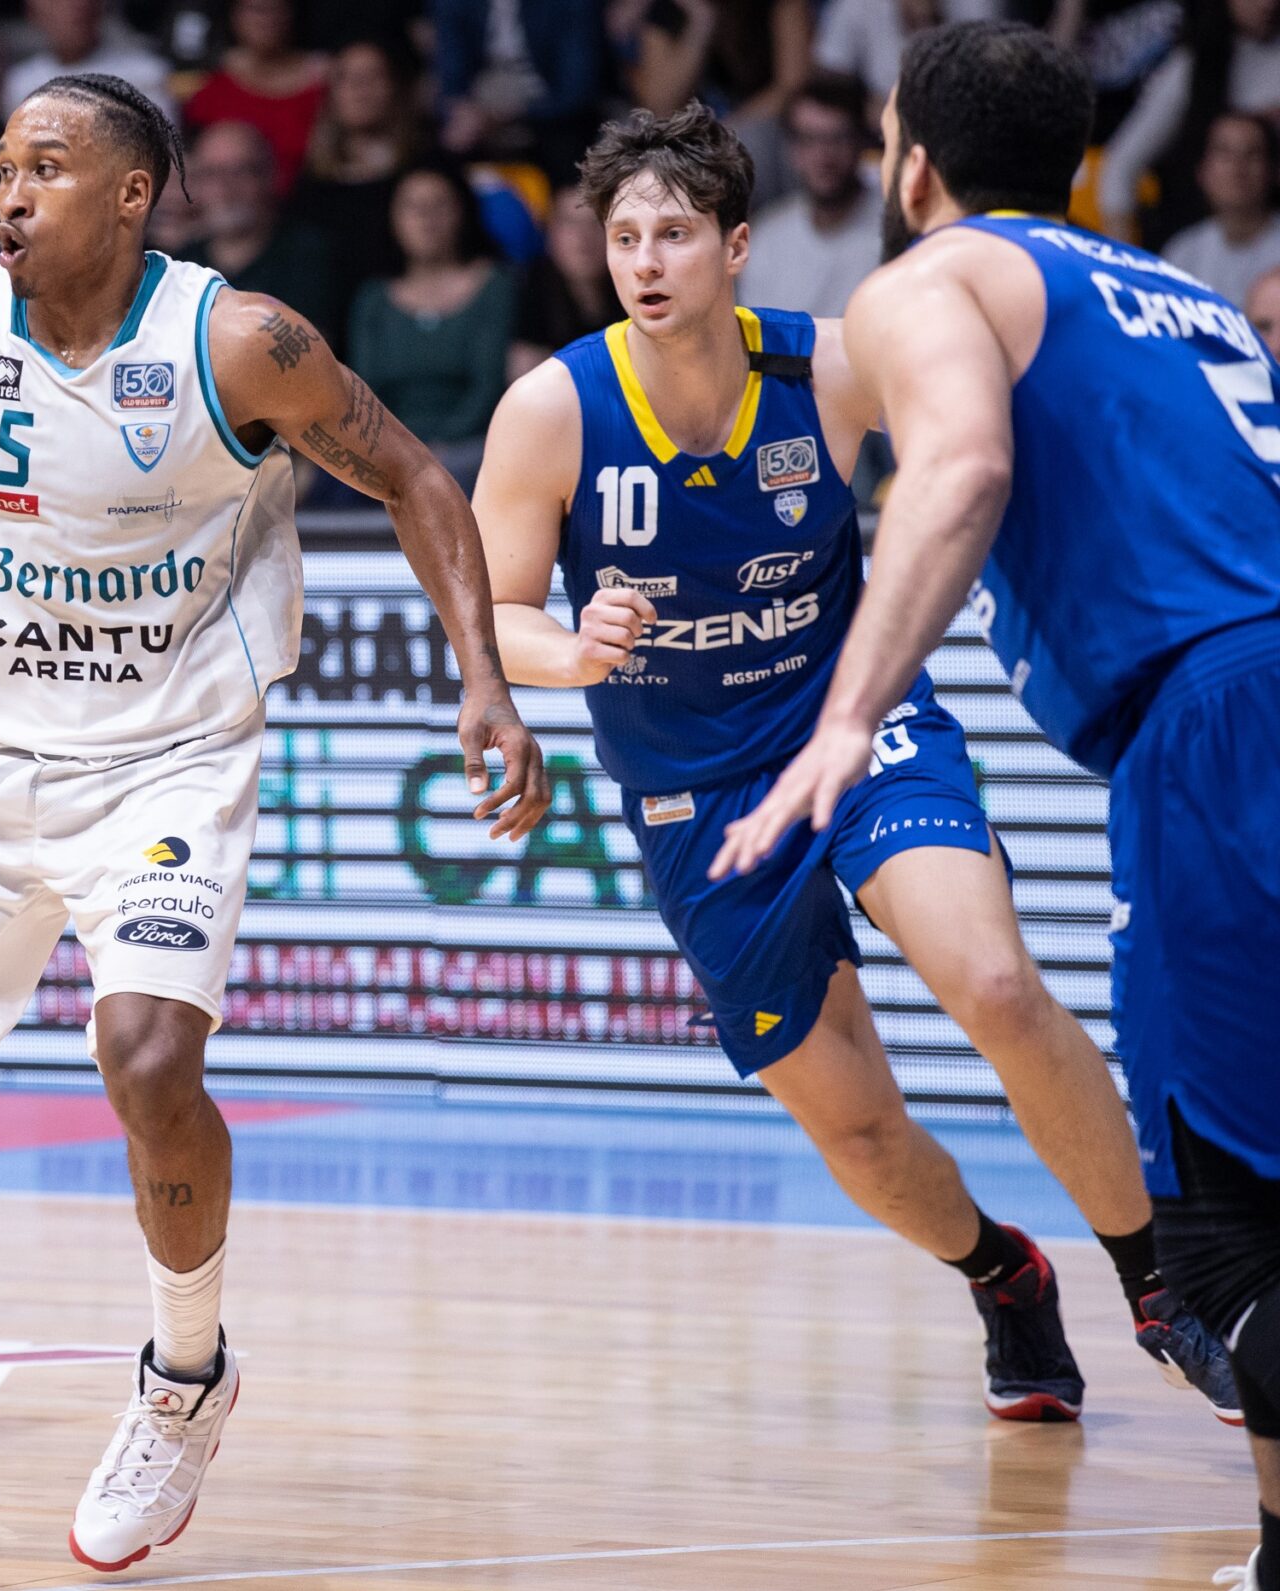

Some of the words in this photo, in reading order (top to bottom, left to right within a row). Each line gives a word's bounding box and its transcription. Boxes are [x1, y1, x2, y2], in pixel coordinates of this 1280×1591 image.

[596, 465, 658, 546] 10
[739, 559, 802, 593] Just
[633, 592, 820, 650] EZENIS
[8, 657, 143, 683] ARENA
[606, 675, 669, 686] ENATO
[180, 873, 223, 894] VIAGGI
[129, 920, 192, 946] Ford
